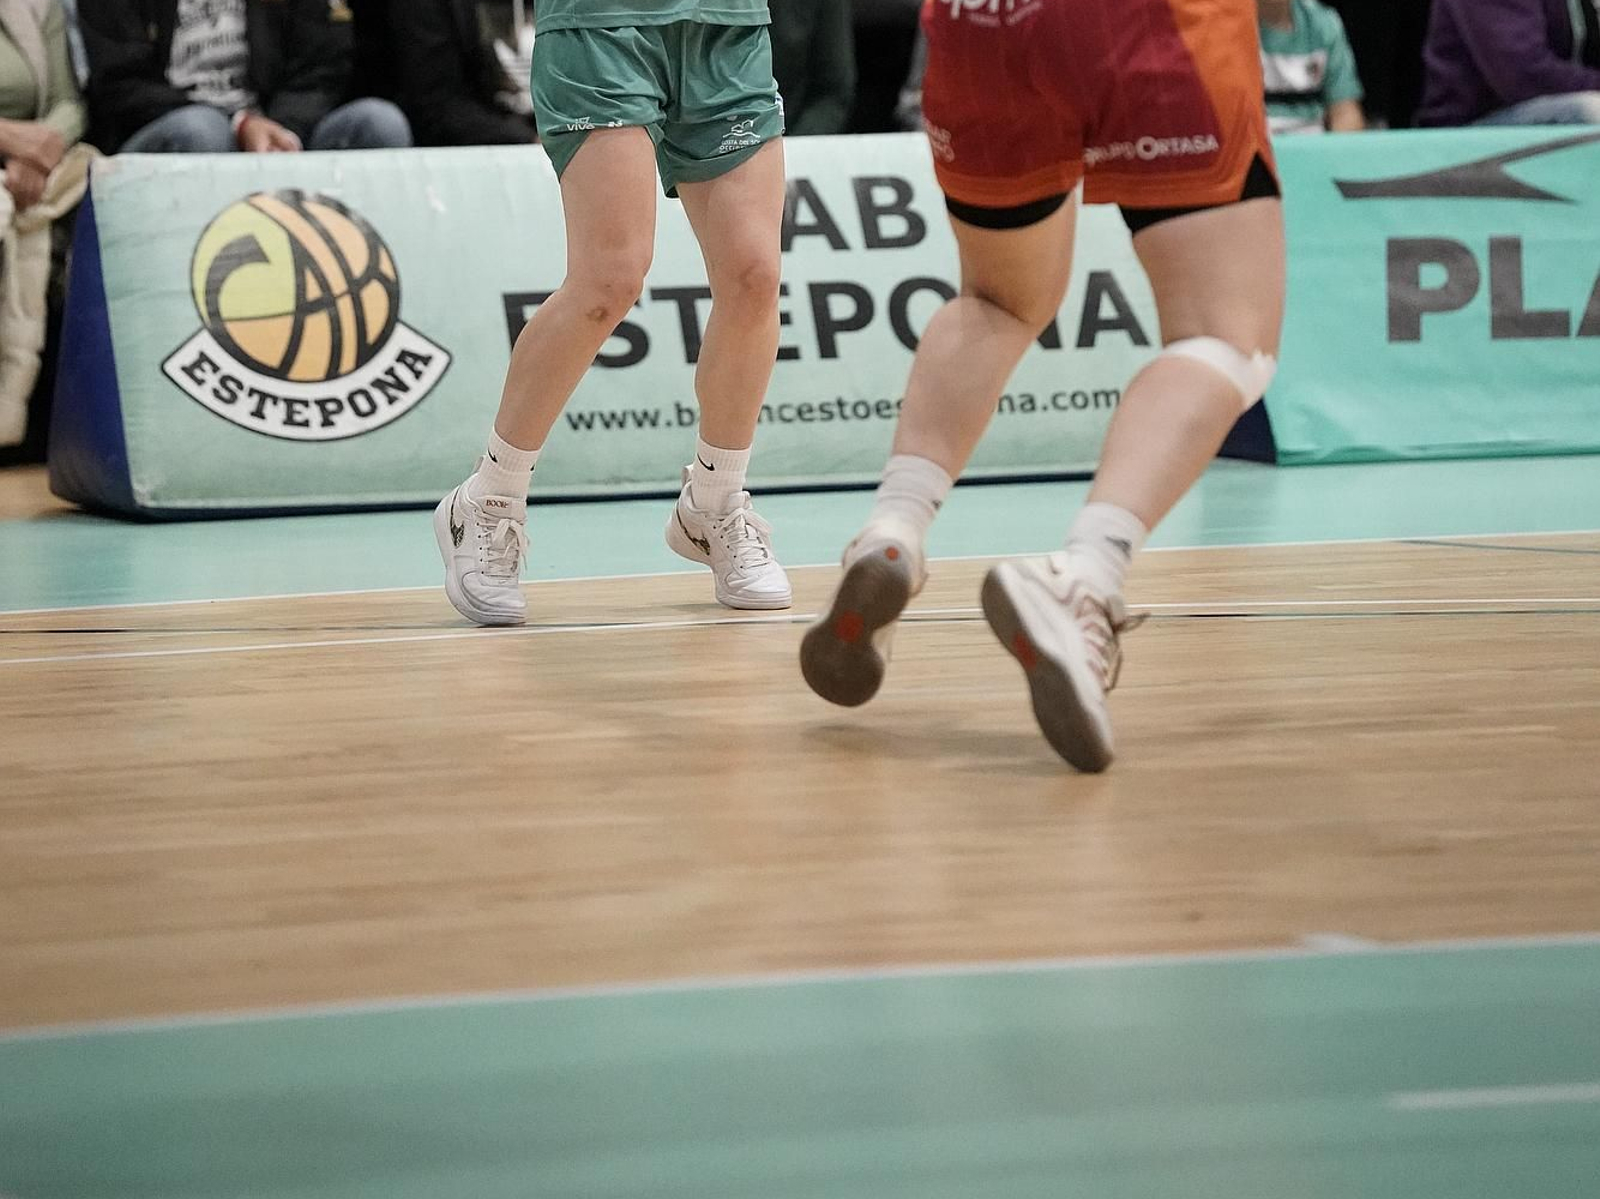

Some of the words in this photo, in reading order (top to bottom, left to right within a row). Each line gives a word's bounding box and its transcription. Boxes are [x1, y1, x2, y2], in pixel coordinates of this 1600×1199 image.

[780, 177, 927, 252] AB
[1386, 235, 1600, 344] PL
[180, 348, 434, 428] ESTEPONA
